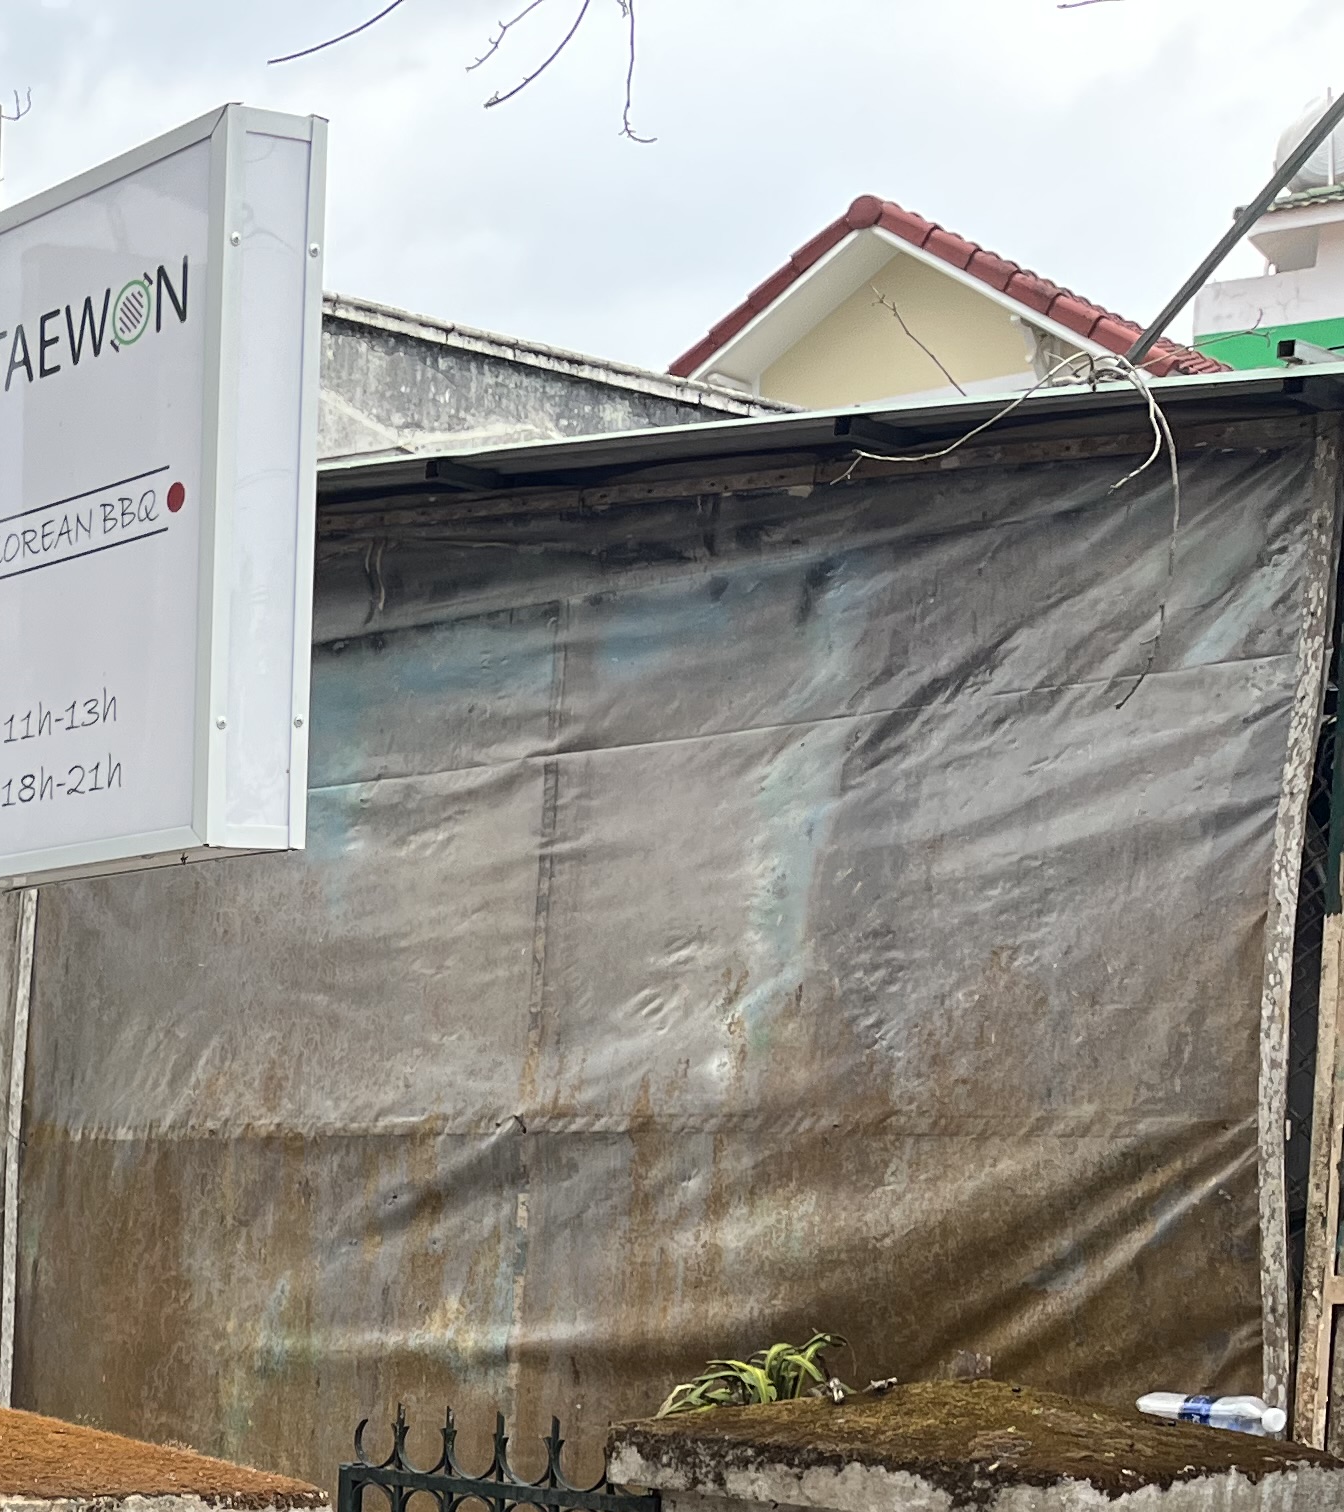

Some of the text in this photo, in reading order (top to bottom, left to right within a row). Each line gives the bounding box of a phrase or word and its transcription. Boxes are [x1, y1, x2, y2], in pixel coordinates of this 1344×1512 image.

[100, 489, 162, 537] BBQ
[3, 688, 117, 744] 11h-13h
[1, 754, 123, 808] 18h-21h
